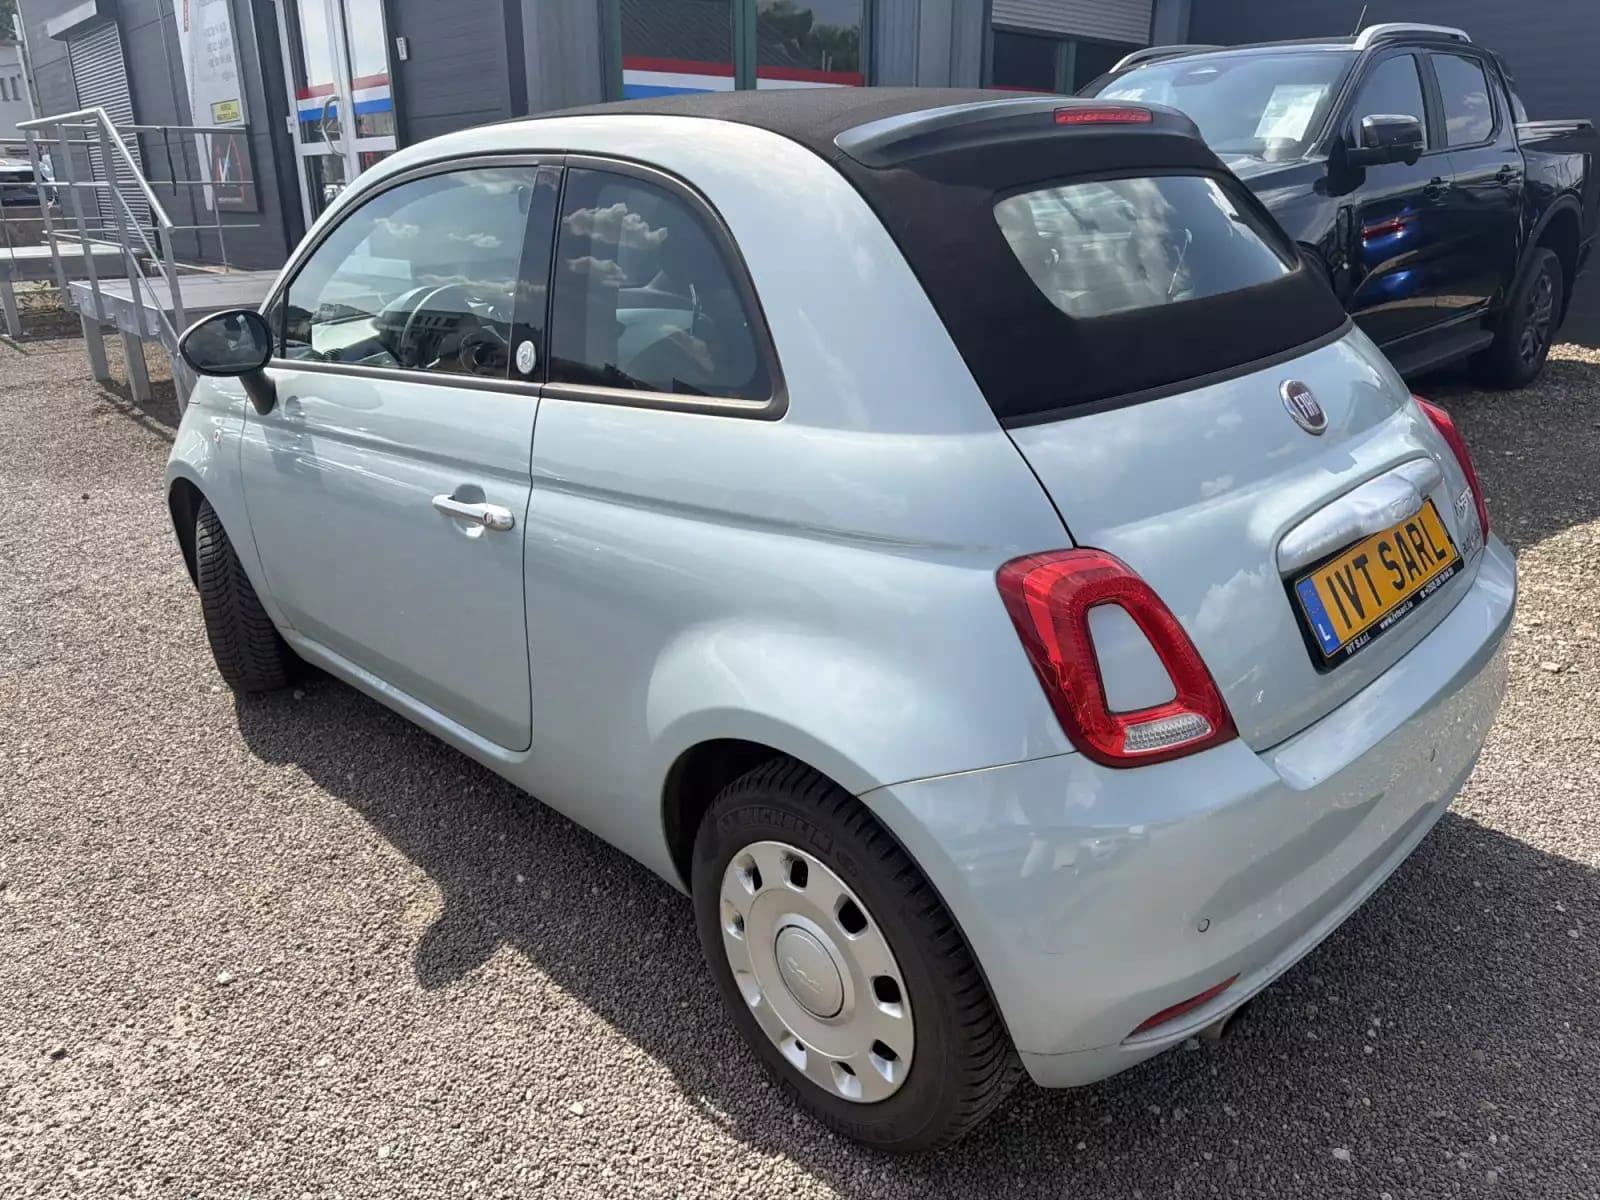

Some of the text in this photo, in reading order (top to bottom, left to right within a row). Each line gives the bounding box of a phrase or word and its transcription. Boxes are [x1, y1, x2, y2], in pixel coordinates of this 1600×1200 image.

[1326, 553, 1382, 630] IVT
[1377, 517, 1447, 591] SARL
[1318, 623, 1331, 642] L
